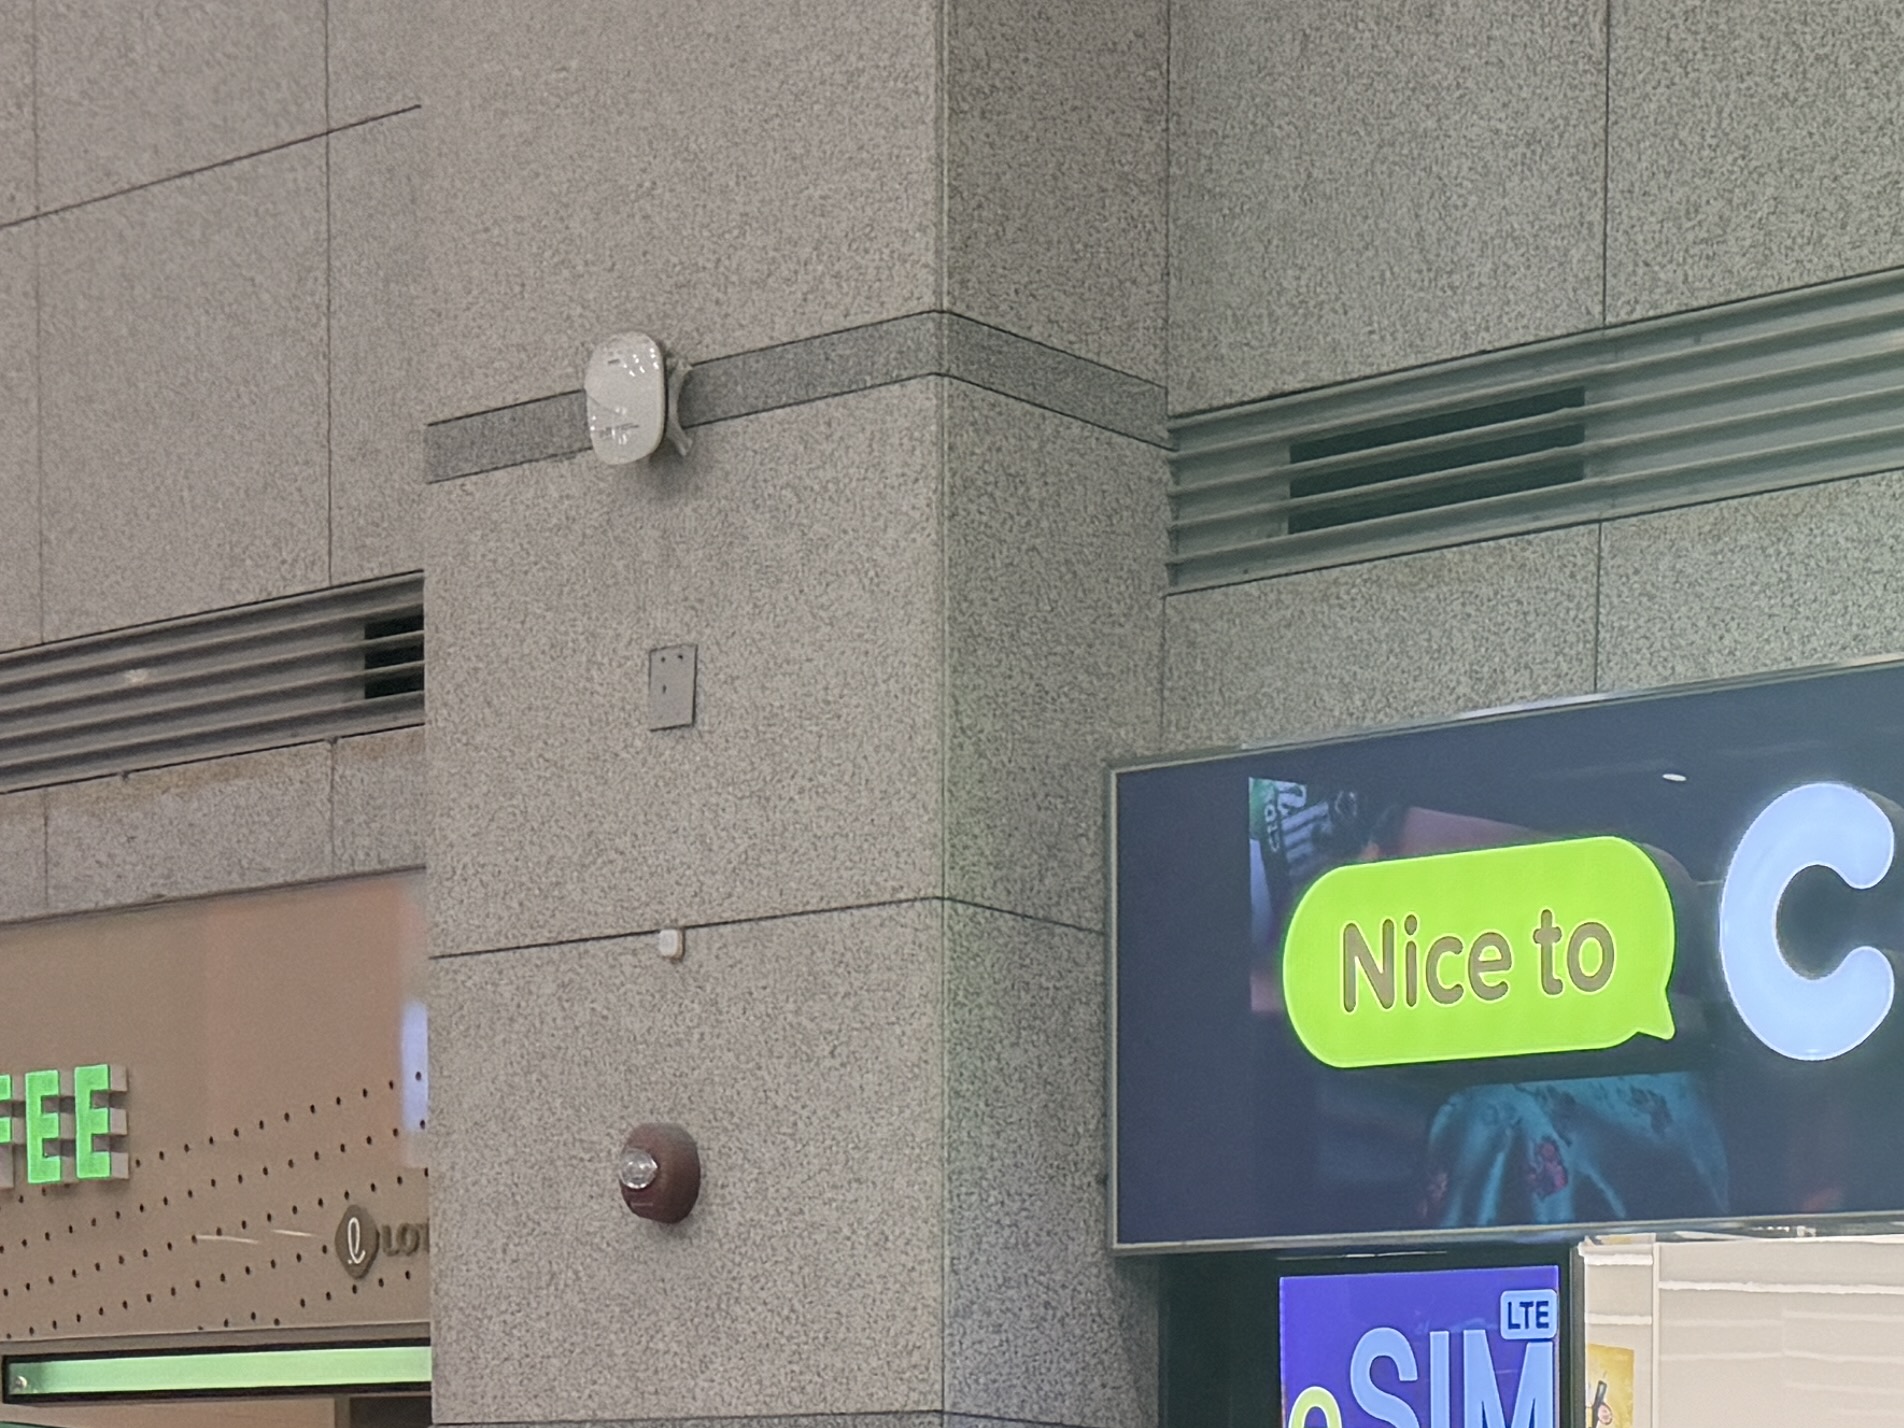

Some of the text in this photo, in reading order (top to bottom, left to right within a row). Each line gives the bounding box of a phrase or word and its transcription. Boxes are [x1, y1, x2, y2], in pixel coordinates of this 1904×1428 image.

[1338, 915, 1513, 1016] Nice
[1530, 907, 1619, 995] to
[1507, 1300, 1550, 1330] LTE
